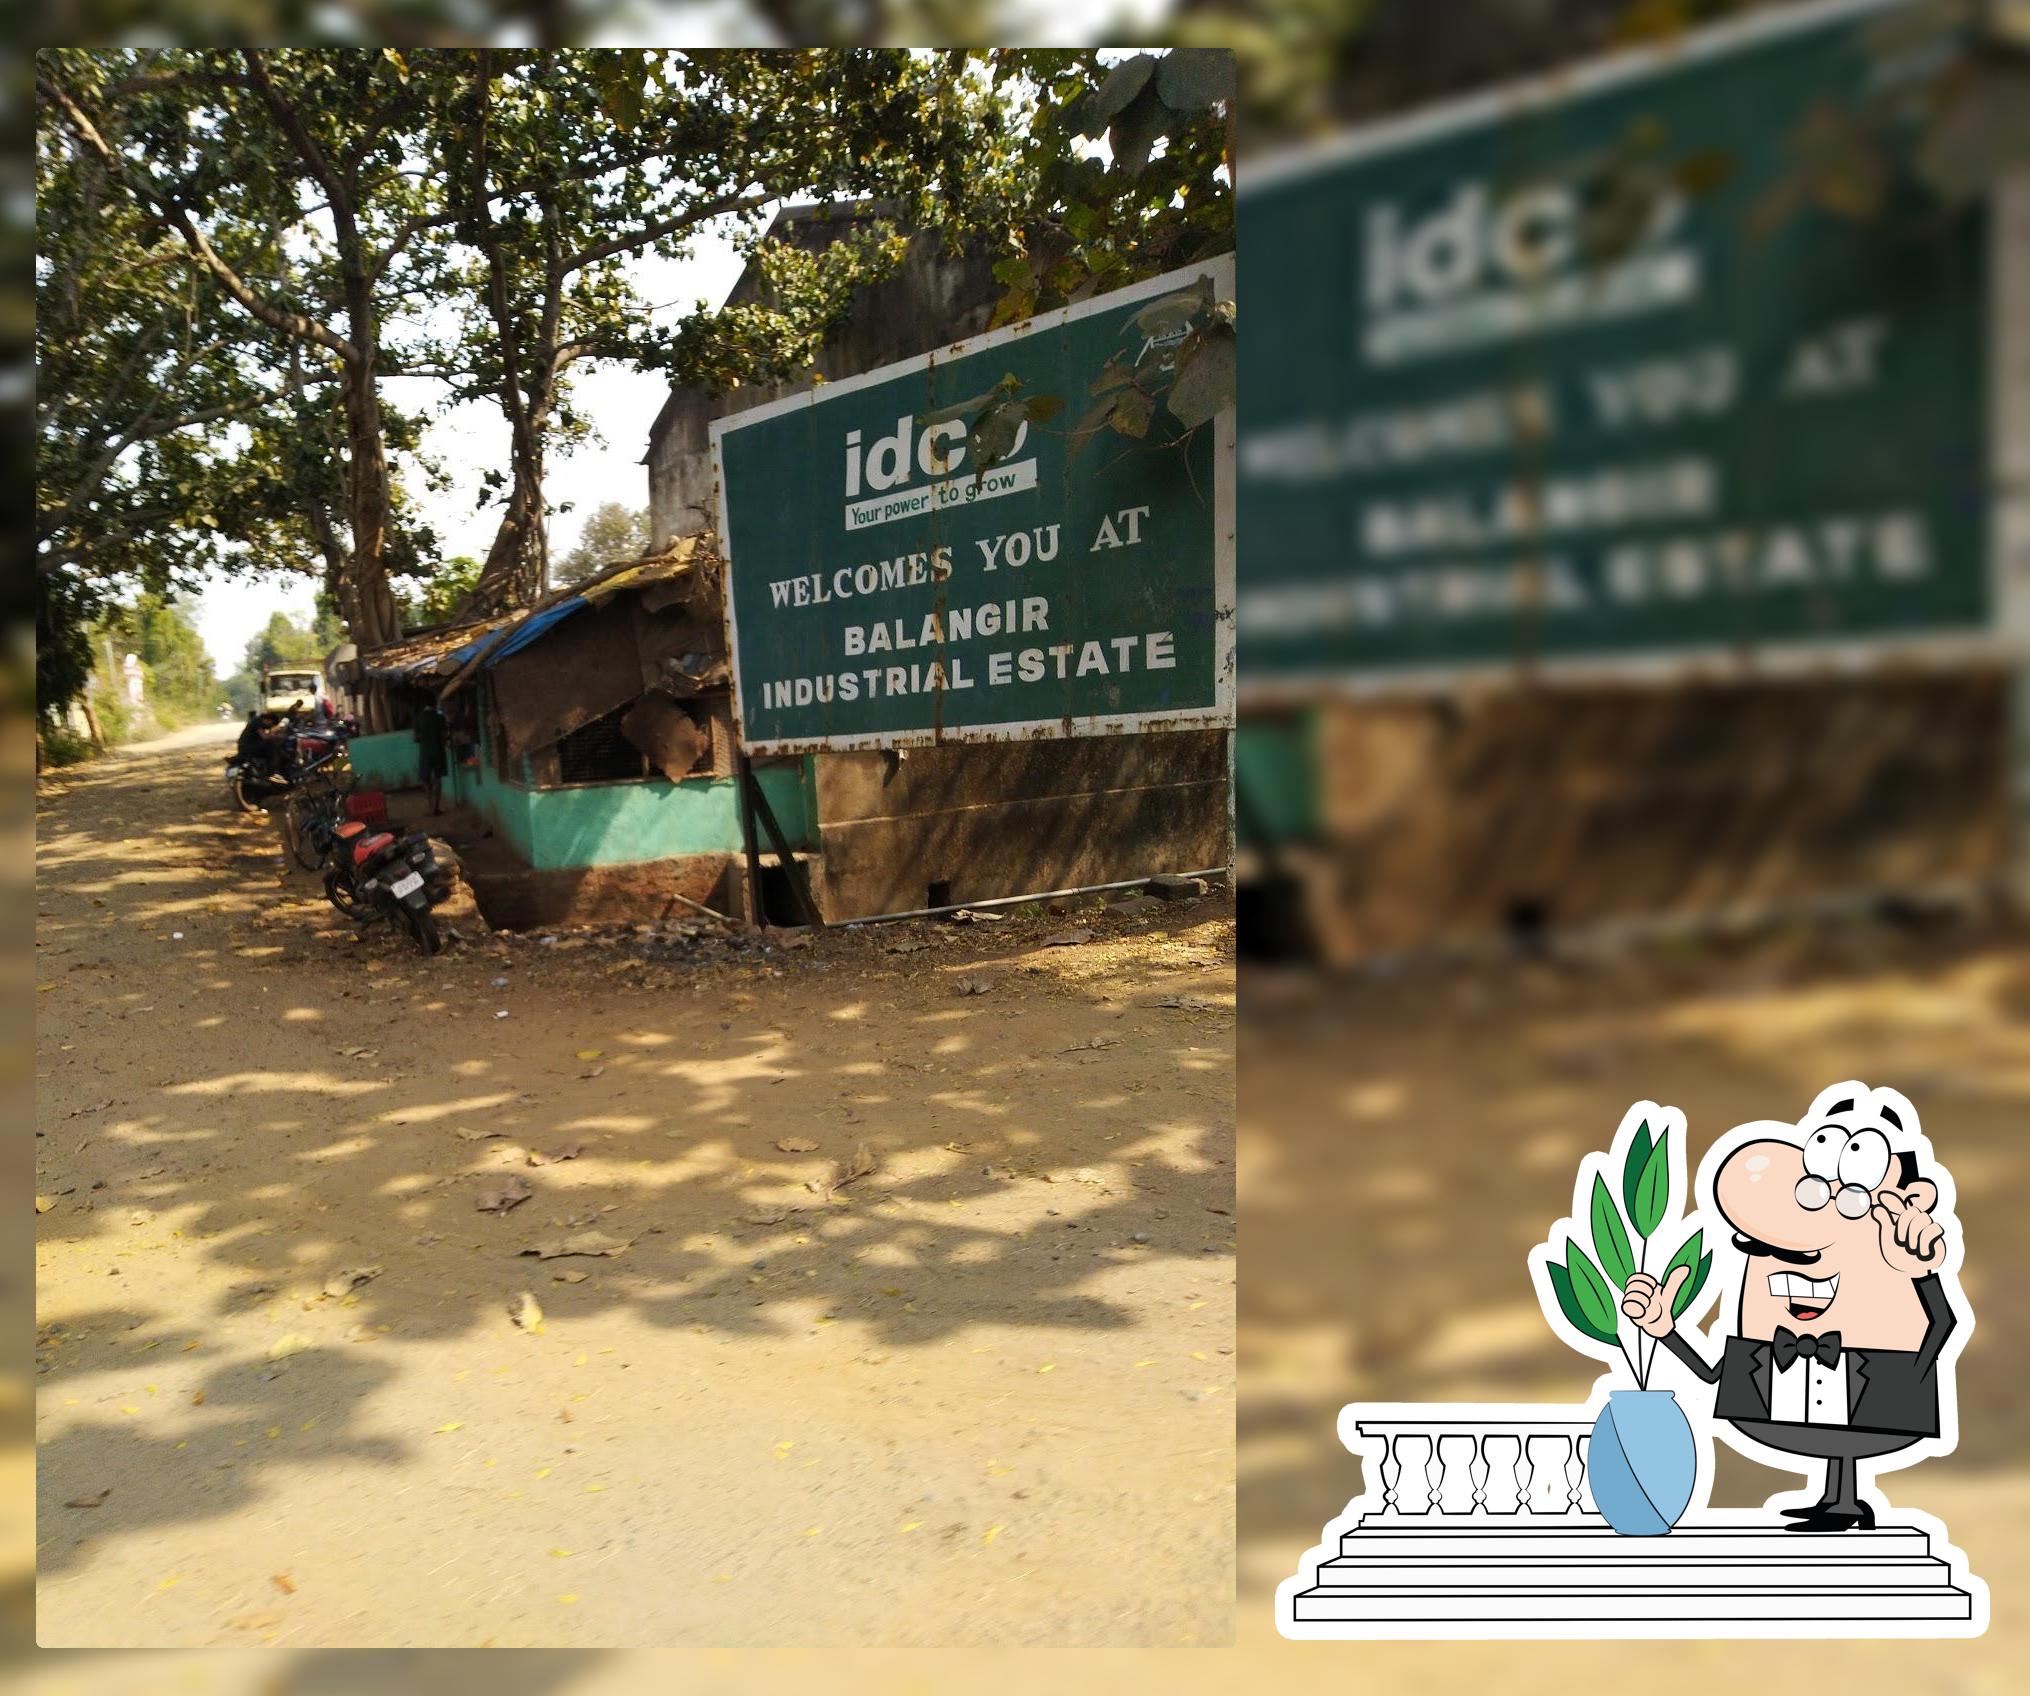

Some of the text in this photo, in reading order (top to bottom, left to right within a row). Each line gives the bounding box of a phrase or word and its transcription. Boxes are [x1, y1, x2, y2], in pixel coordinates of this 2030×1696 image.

[852, 507, 882, 526] Your
[884, 494, 930, 521] power
[938, 487, 959, 505] to
[769, 505, 1151, 610] WELCOMES YOU AT
[844, 596, 1050, 657] BALANGIR
[762, 631, 1177, 711] INDUSTRIAL ESTATE
